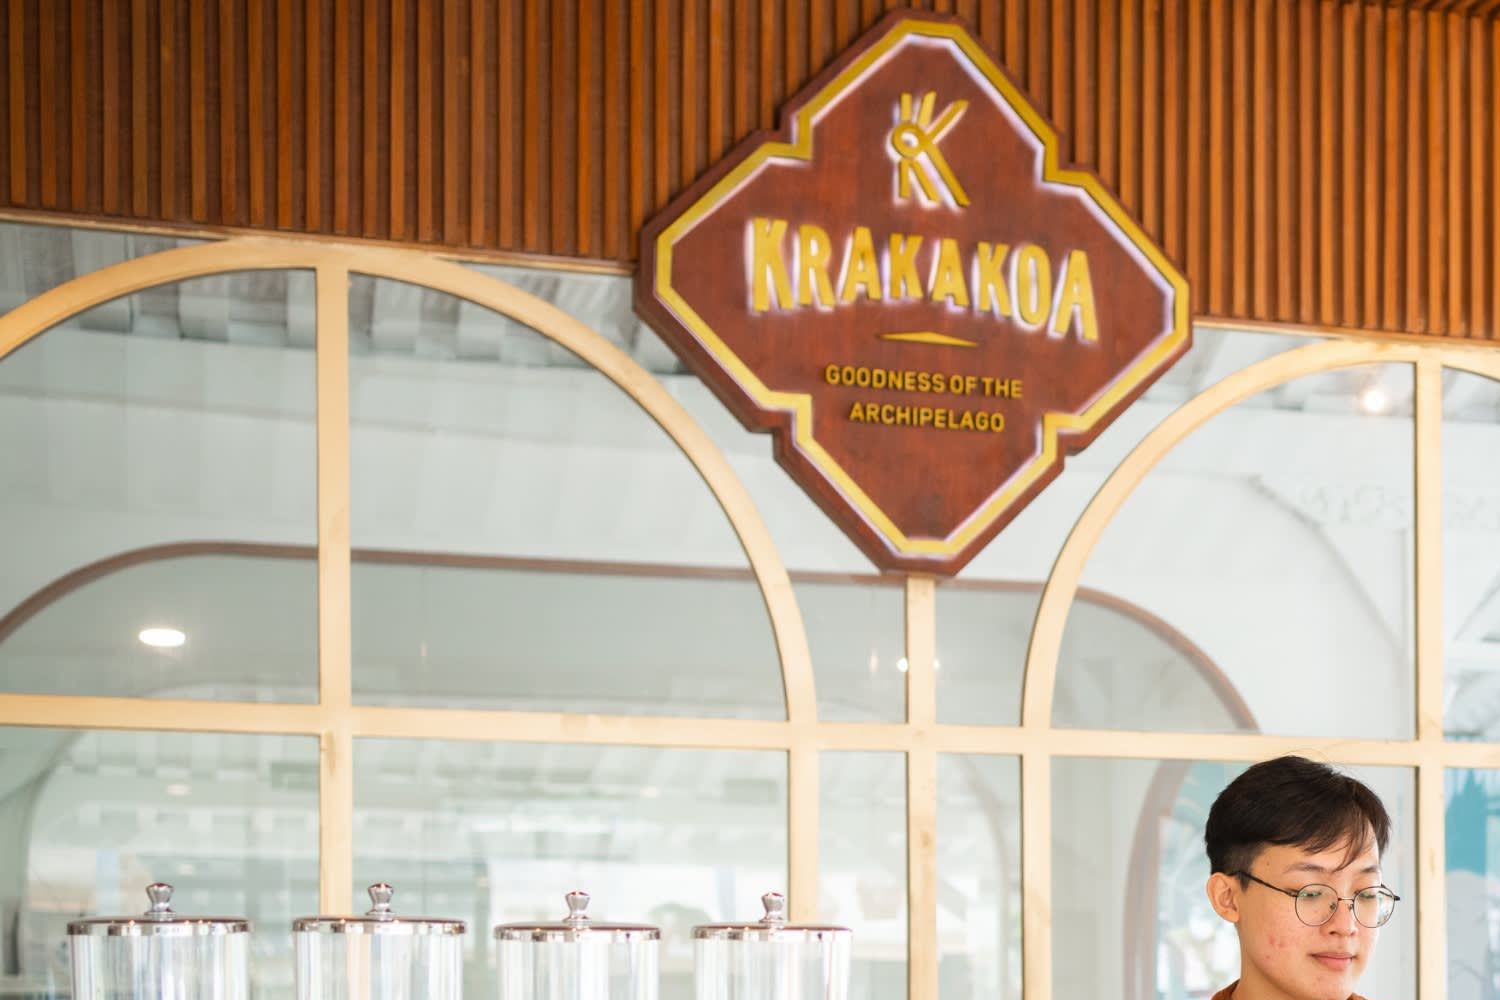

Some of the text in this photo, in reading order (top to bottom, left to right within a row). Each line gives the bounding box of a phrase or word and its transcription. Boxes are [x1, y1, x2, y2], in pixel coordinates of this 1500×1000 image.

[748, 217, 1099, 342] KRAKAKOA
[825, 364, 1023, 399] GOODNESS OF THE
[849, 401, 1005, 433] ARCHIPELAGO
